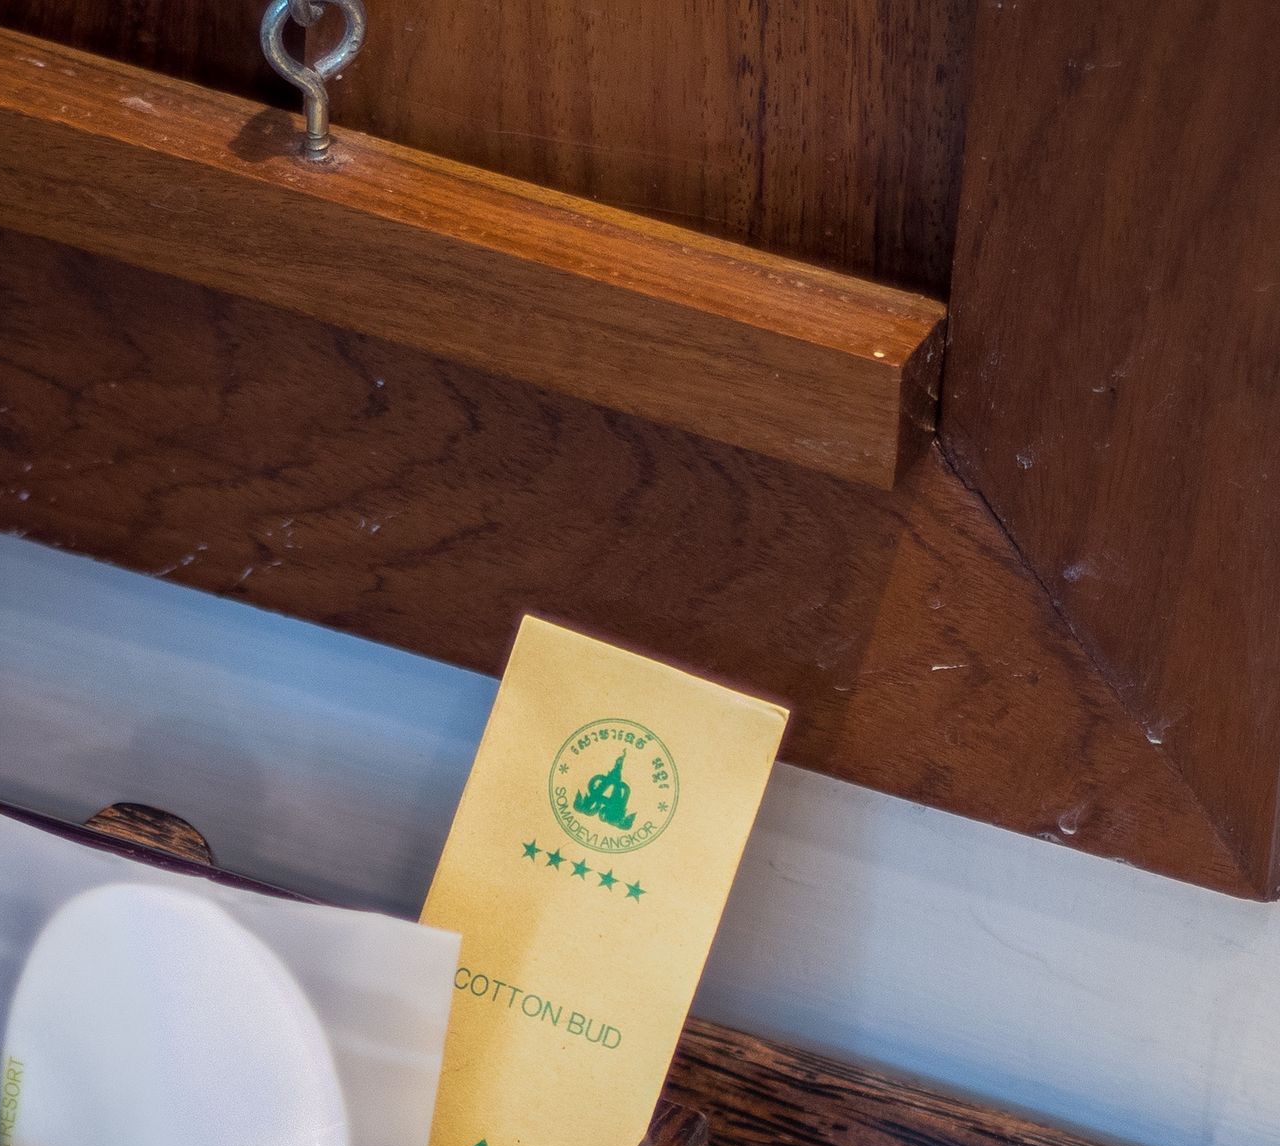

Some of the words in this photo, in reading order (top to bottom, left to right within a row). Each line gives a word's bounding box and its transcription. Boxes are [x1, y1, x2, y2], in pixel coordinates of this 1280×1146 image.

[555, 786, 599, 845] SOMADEVI
[600, 820, 657, 849] ANGKOR
[454, 967, 563, 1026] COTTON
[566, 1011, 621, 1049] BUD
[0, 1055, 24, 1138] RESORT
